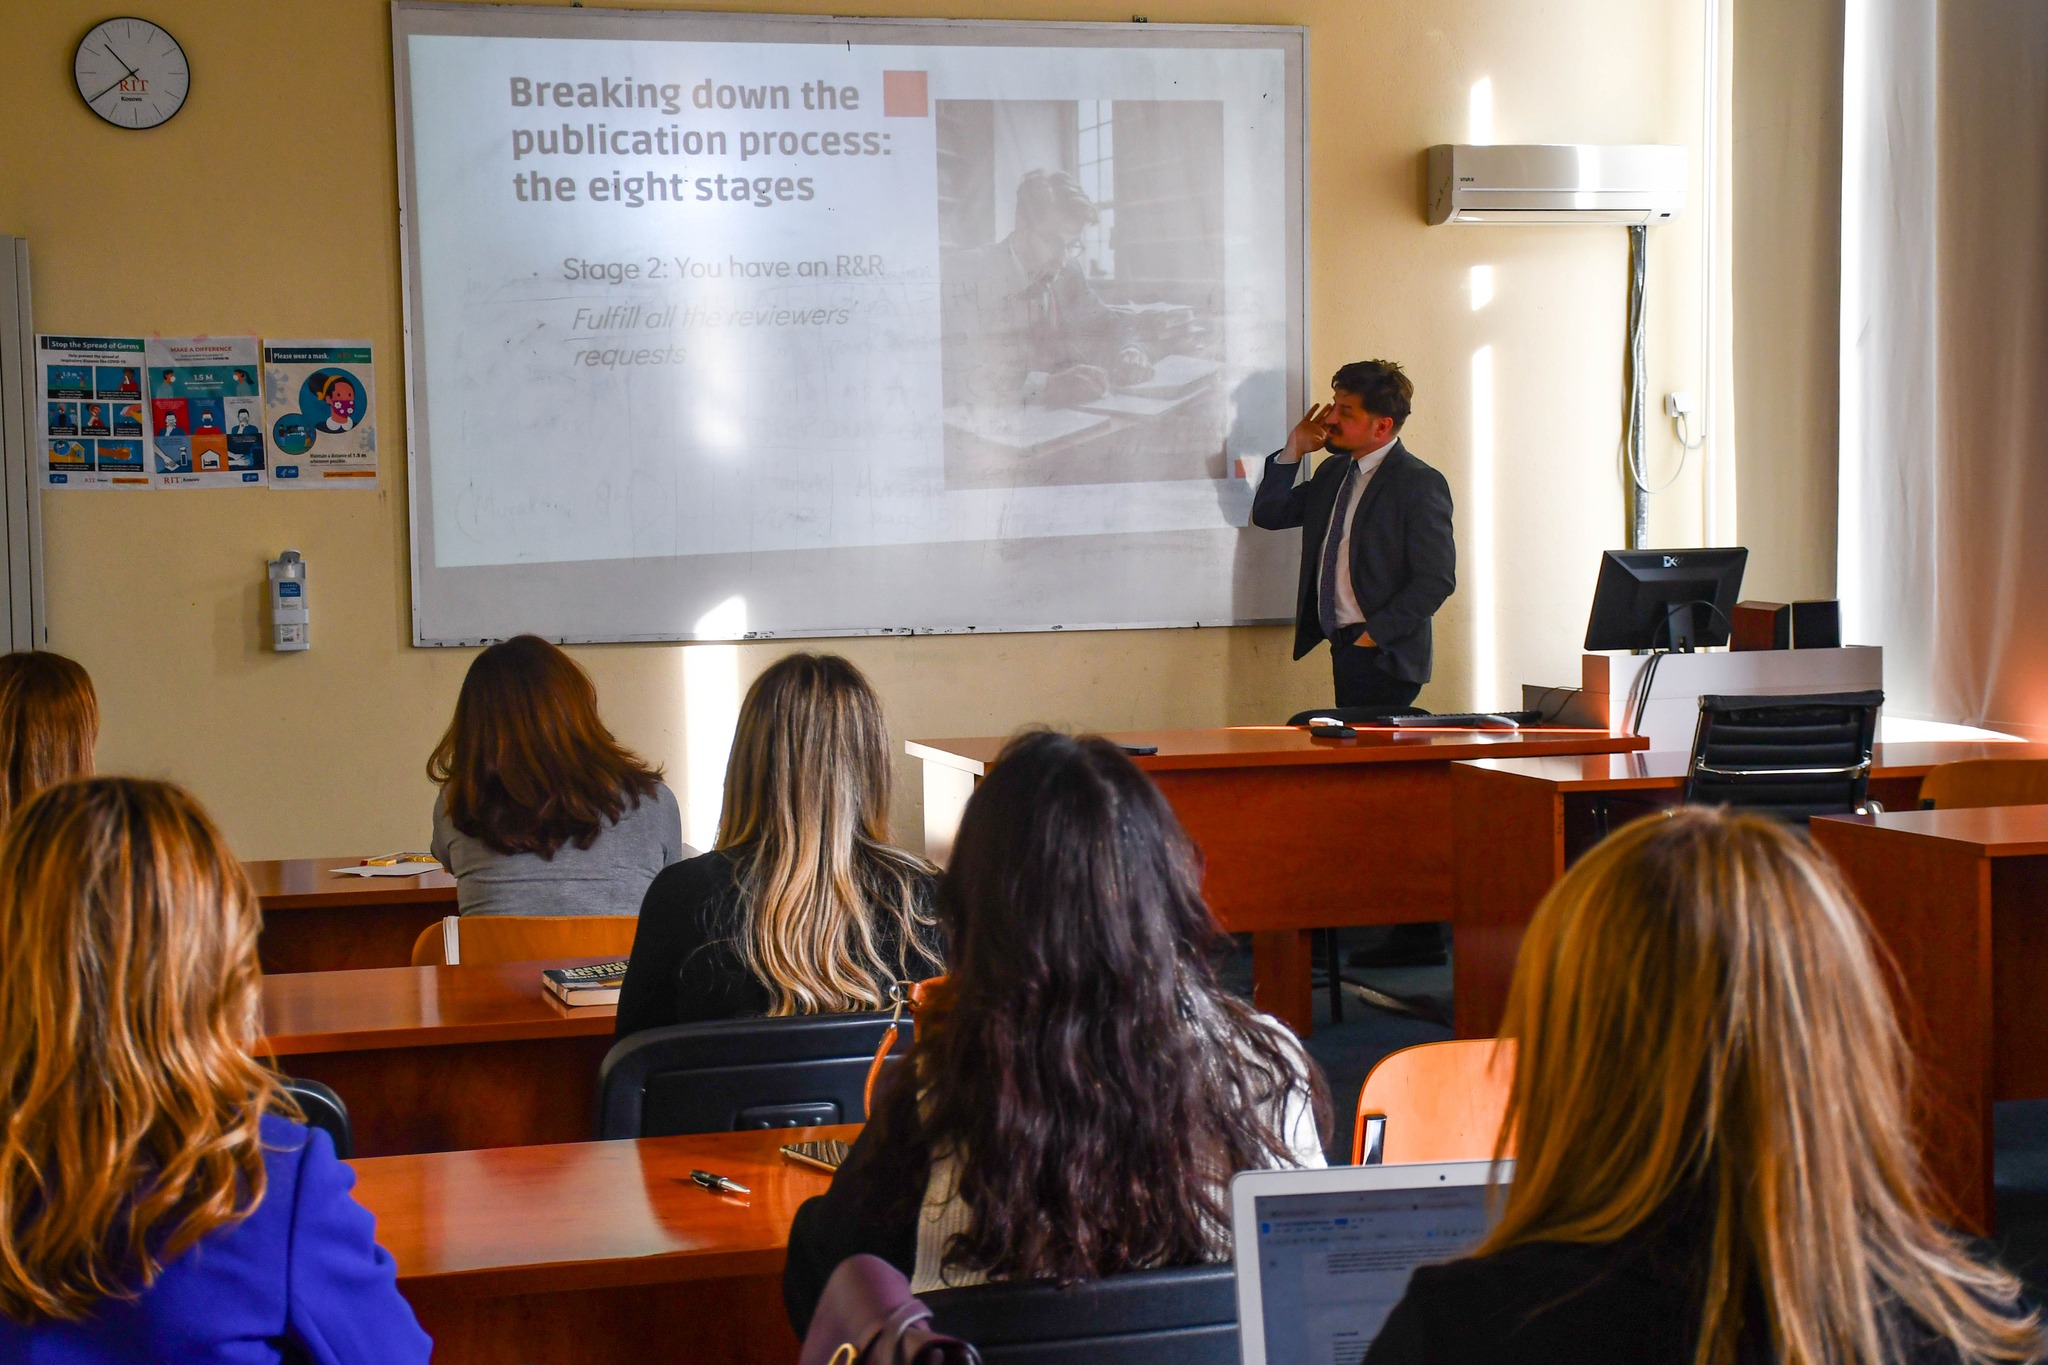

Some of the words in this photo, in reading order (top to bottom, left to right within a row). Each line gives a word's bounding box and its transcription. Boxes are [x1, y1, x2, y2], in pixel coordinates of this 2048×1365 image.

[119, 80, 148, 92] RIT
[509, 76, 681, 115] Breaking
[692, 78, 789, 110] down
[801, 80, 859, 110] the
[511, 123, 726, 160] publication
[740, 130, 891, 161] process:
[513, 170, 576, 202] the
[588, 170, 684, 208] eight
[695, 172, 815, 208] stages
[563, 257, 640, 284] Stage
[647, 257, 668, 279] 2:
[674, 256, 722, 278] You
[729, 255, 790, 278] have
[797, 260, 828, 276] an
[836, 254, 885, 277] R&R
[572, 305, 642, 331] Fulfill
[645, 305, 675, 329] all
[681, 304, 723, 328] the
[573, 344, 687, 371] requests
[564, 964, 628, 977] ACTIO
